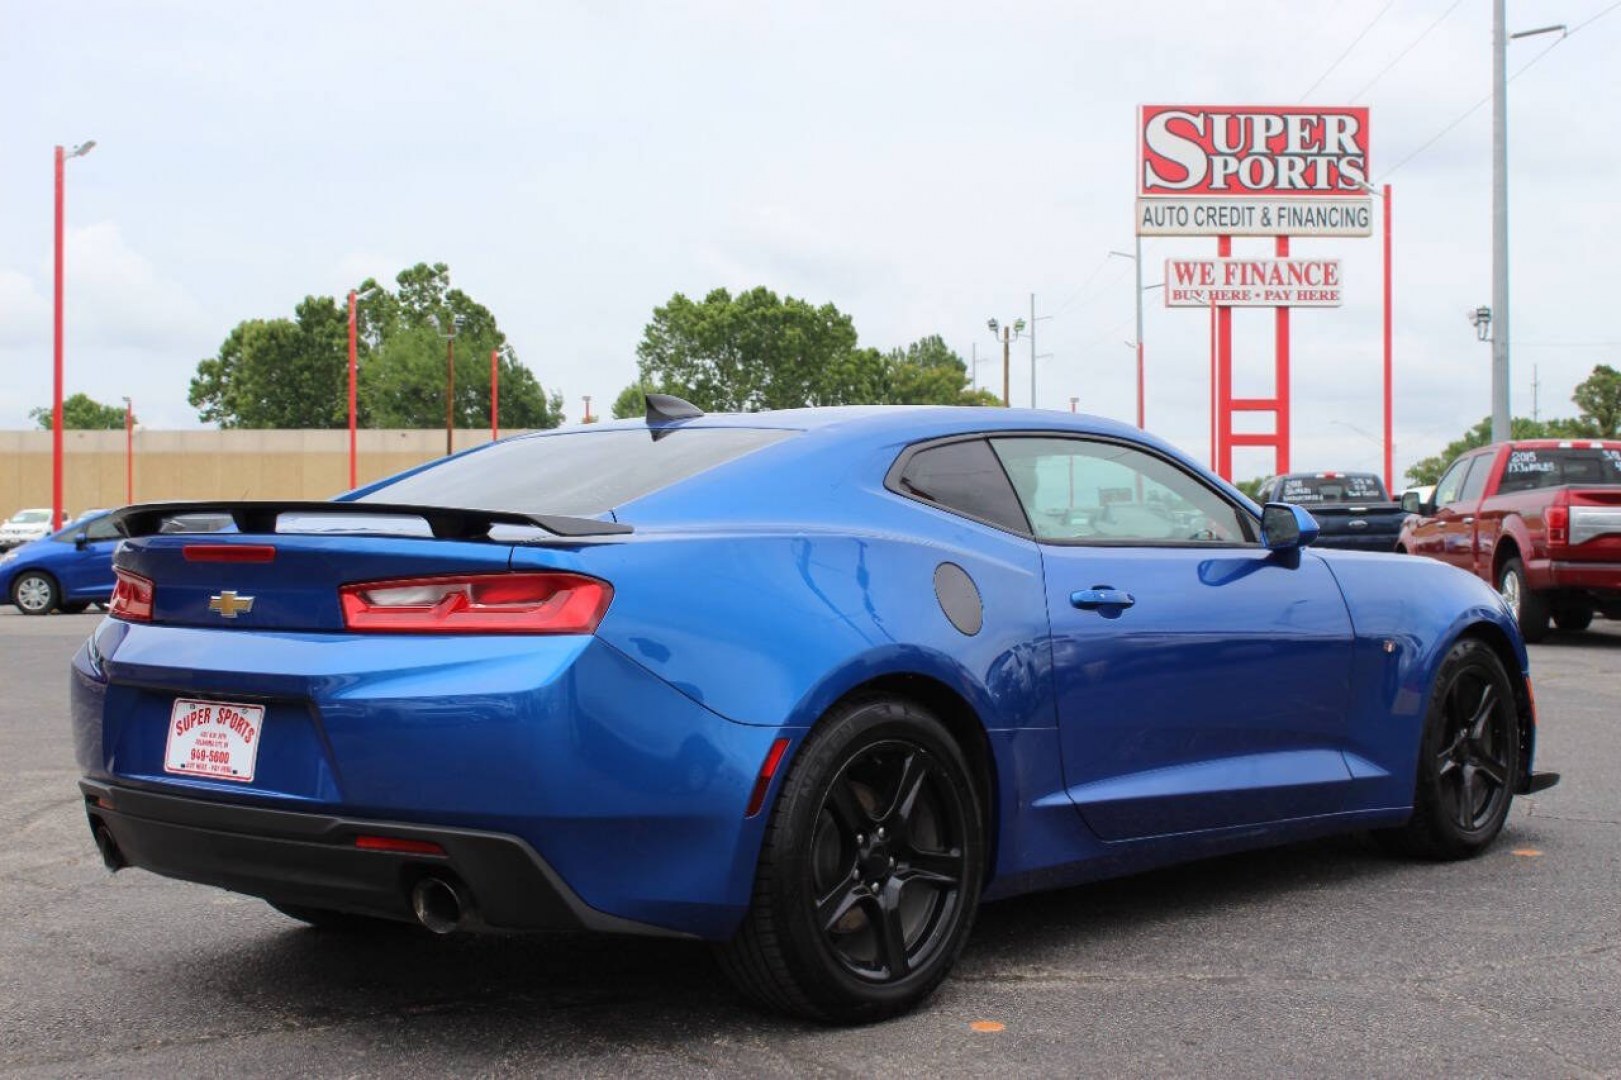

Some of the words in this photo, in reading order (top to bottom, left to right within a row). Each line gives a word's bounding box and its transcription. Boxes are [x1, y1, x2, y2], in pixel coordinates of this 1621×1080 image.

[1145, 110, 1364, 189] SUPER
[1143, 206, 1188, 227] AUTO
[1194, 206, 1255, 227] CREDIT
[1261, 208, 1272, 226] &
[1277, 207, 1369, 228] FINANCING
[1173, 262, 1215, 286] WE
[1223, 262, 1338, 286] FINANCE
[1173, 290, 1204, 301] BUY
[1208, 290, 1252, 301] HERE
[1264, 290, 1291, 301] PAY
[1297, 290, 1340, 301] HERE
[176, 707, 211, 736] SUPER
[217, 707, 255, 743] SPORTS
[190, 748, 230, 764] 949-5600
